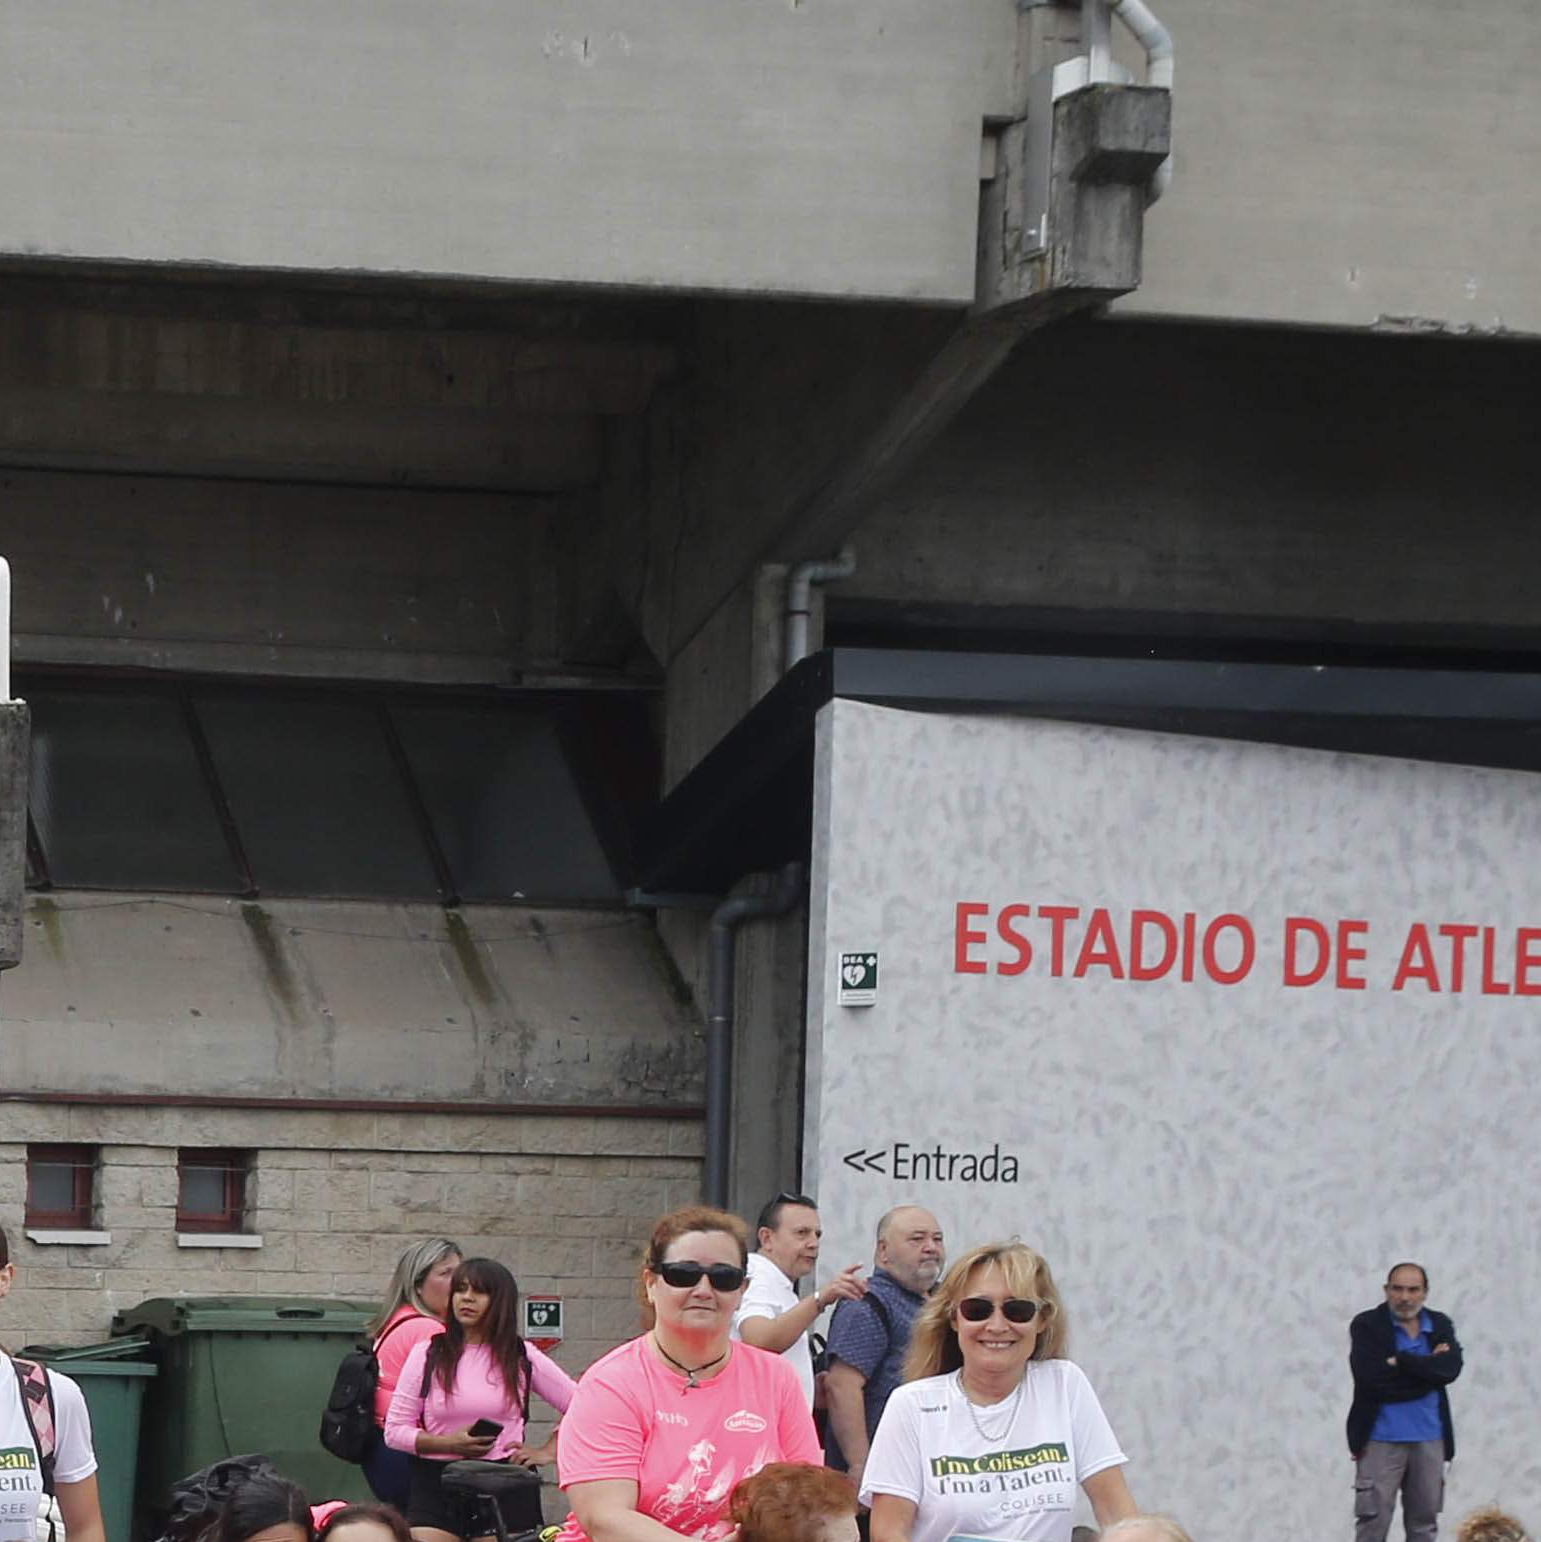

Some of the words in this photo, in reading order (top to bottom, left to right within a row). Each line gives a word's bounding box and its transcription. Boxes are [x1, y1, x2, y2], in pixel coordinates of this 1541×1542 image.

[843, 956, 863, 964] DEA
[954, 901, 1256, 986] ESTADIO
[1283, 917, 1369, 990] DE
[1392, 922, 1541, 998] ATLE
[892, 1142, 1019, 1183] Entrada
[936, 1457, 970, 1477] I'm
[973, 1448, 1069, 1473] Colisean.
[939, 1477, 974, 1495] I'm
[979, 1482, 991, 1494] a
[996, 1467, 1072, 1491] Talent.
[1000, 1493, 1064, 1512] COLISEE
